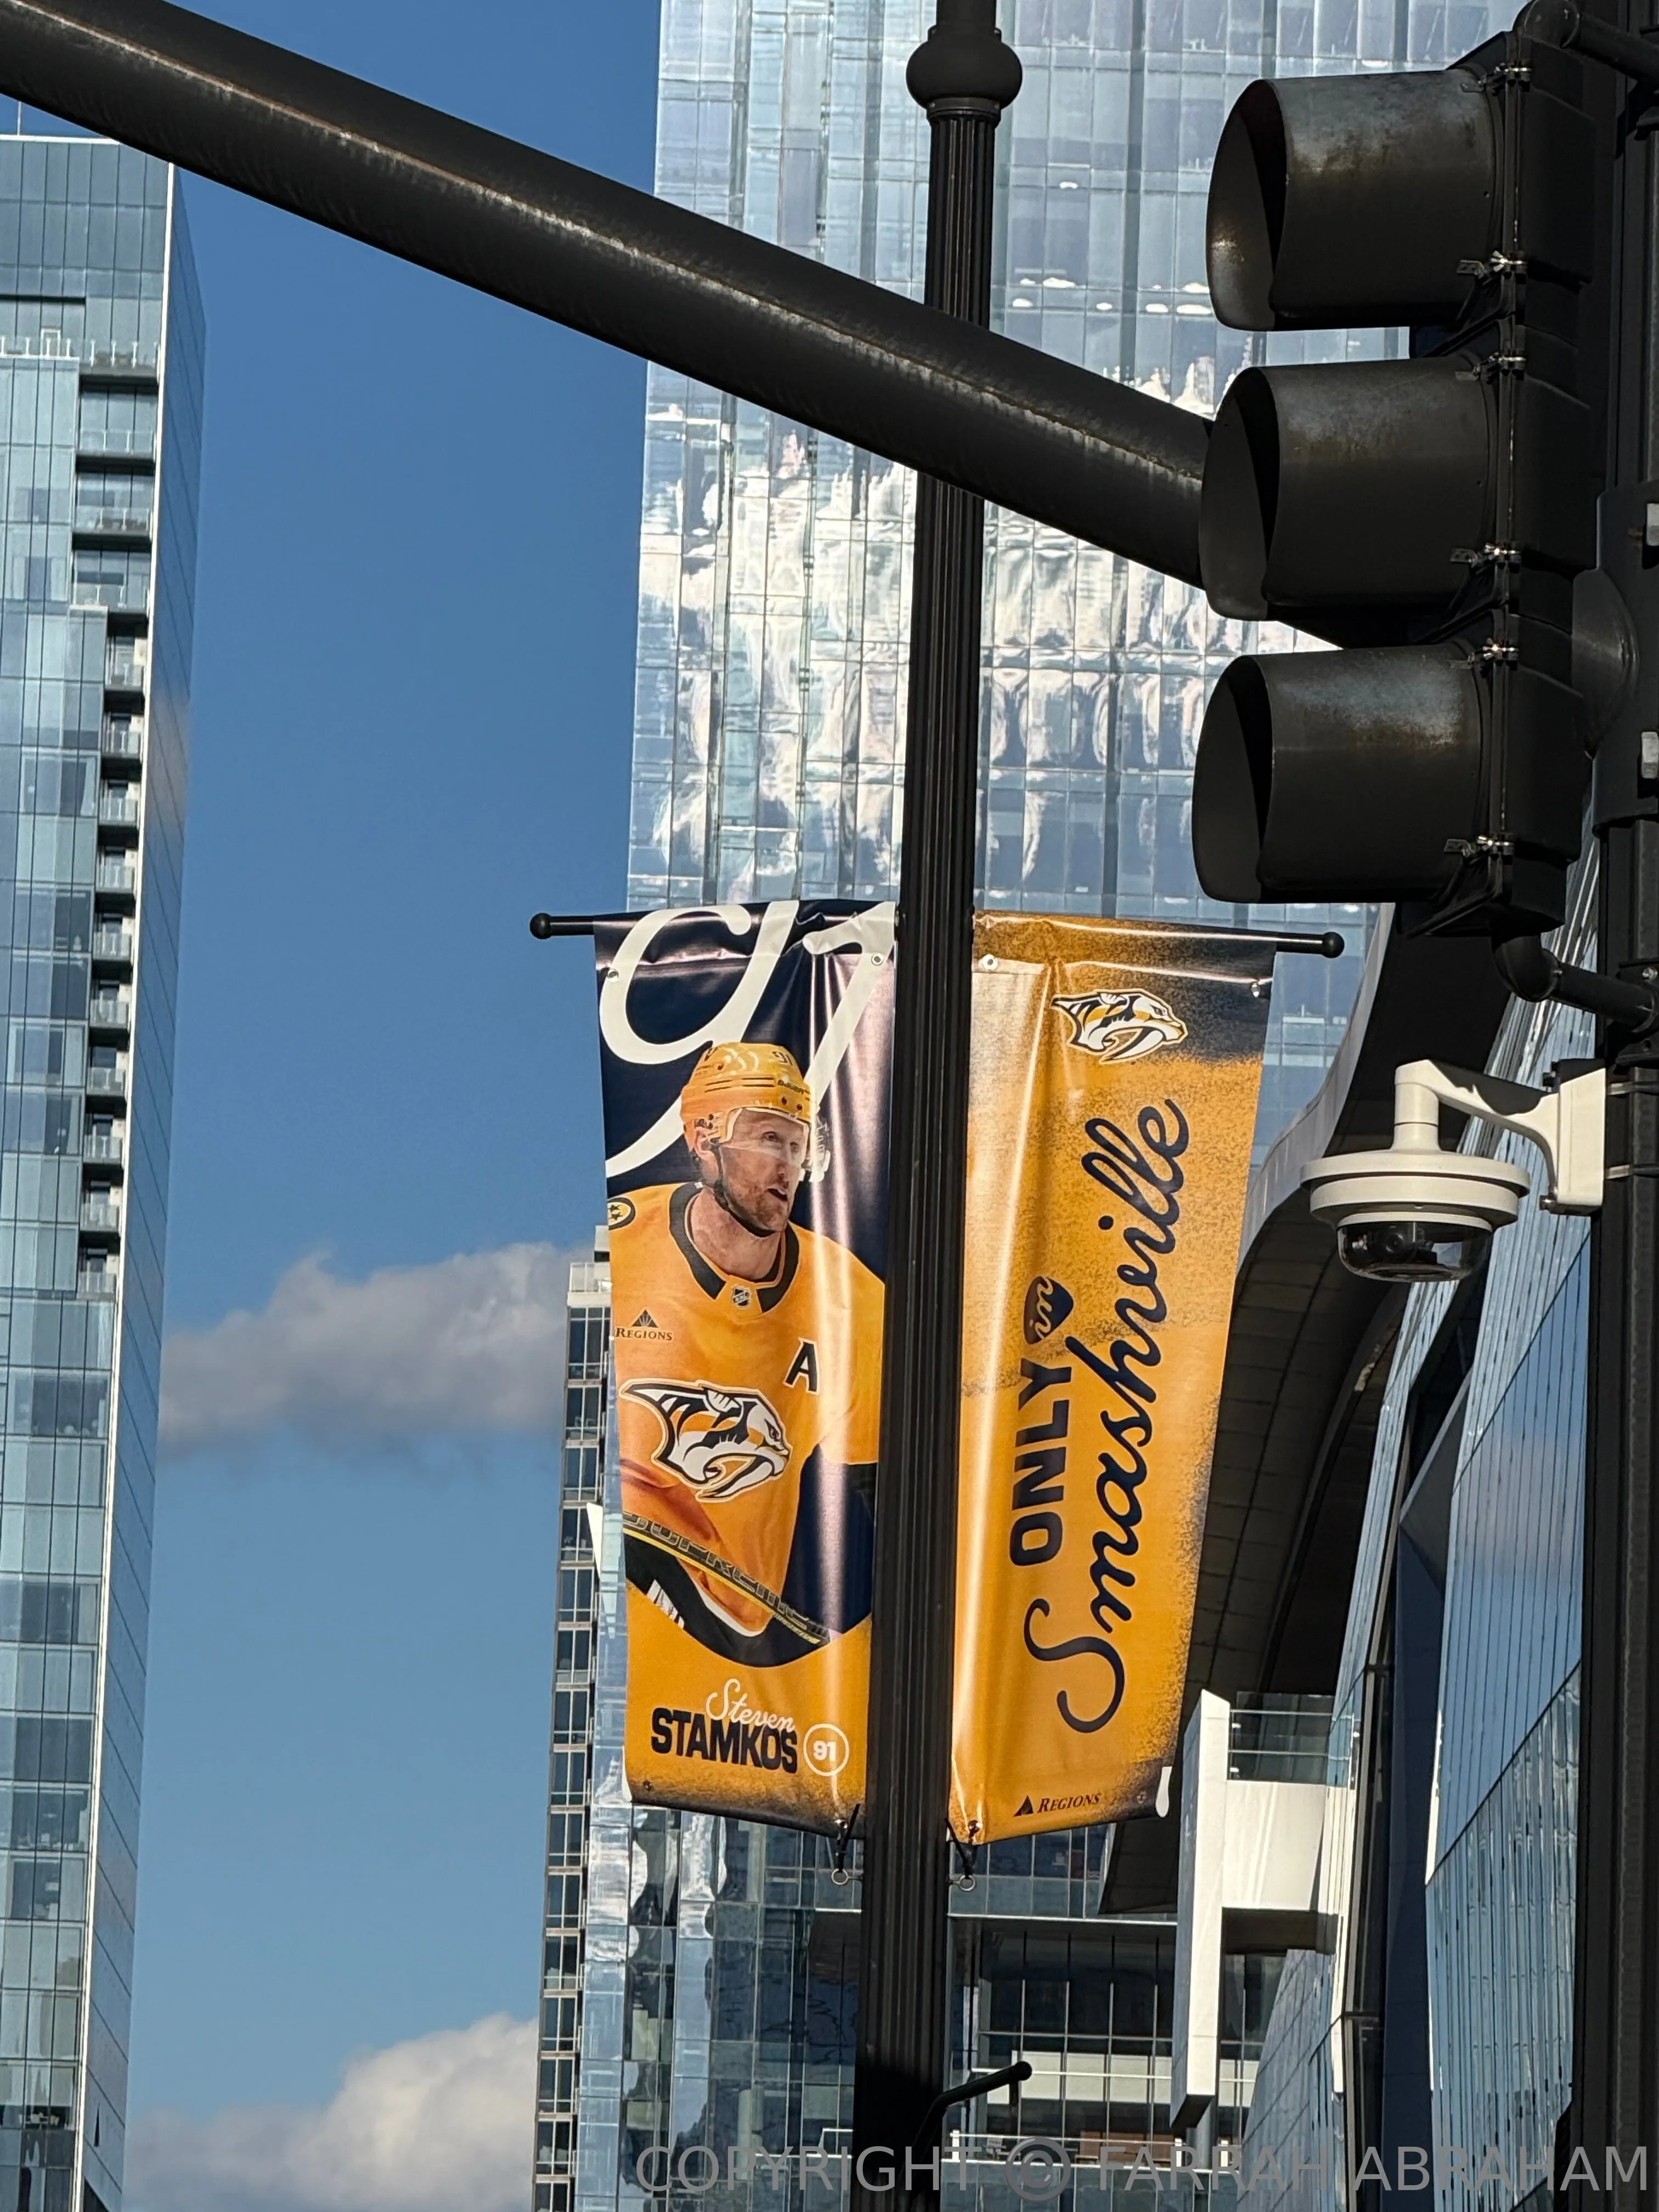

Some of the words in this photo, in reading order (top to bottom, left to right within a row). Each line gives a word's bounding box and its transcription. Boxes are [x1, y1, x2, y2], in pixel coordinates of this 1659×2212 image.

[615, 1327, 673, 1341] REGIONS
[785, 1341, 819, 1393] A
[1024, 1098, 1189, 1734] Smashville
[1009, 1357, 1072, 1567] ONLY
[706, 1678, 797, 1733] Steven
[651, 1707, 798, 1774] STAMKOS
[813, 1740, 837, 1763] 91
[1037, 1793, 1102, 1813] REGIONS
